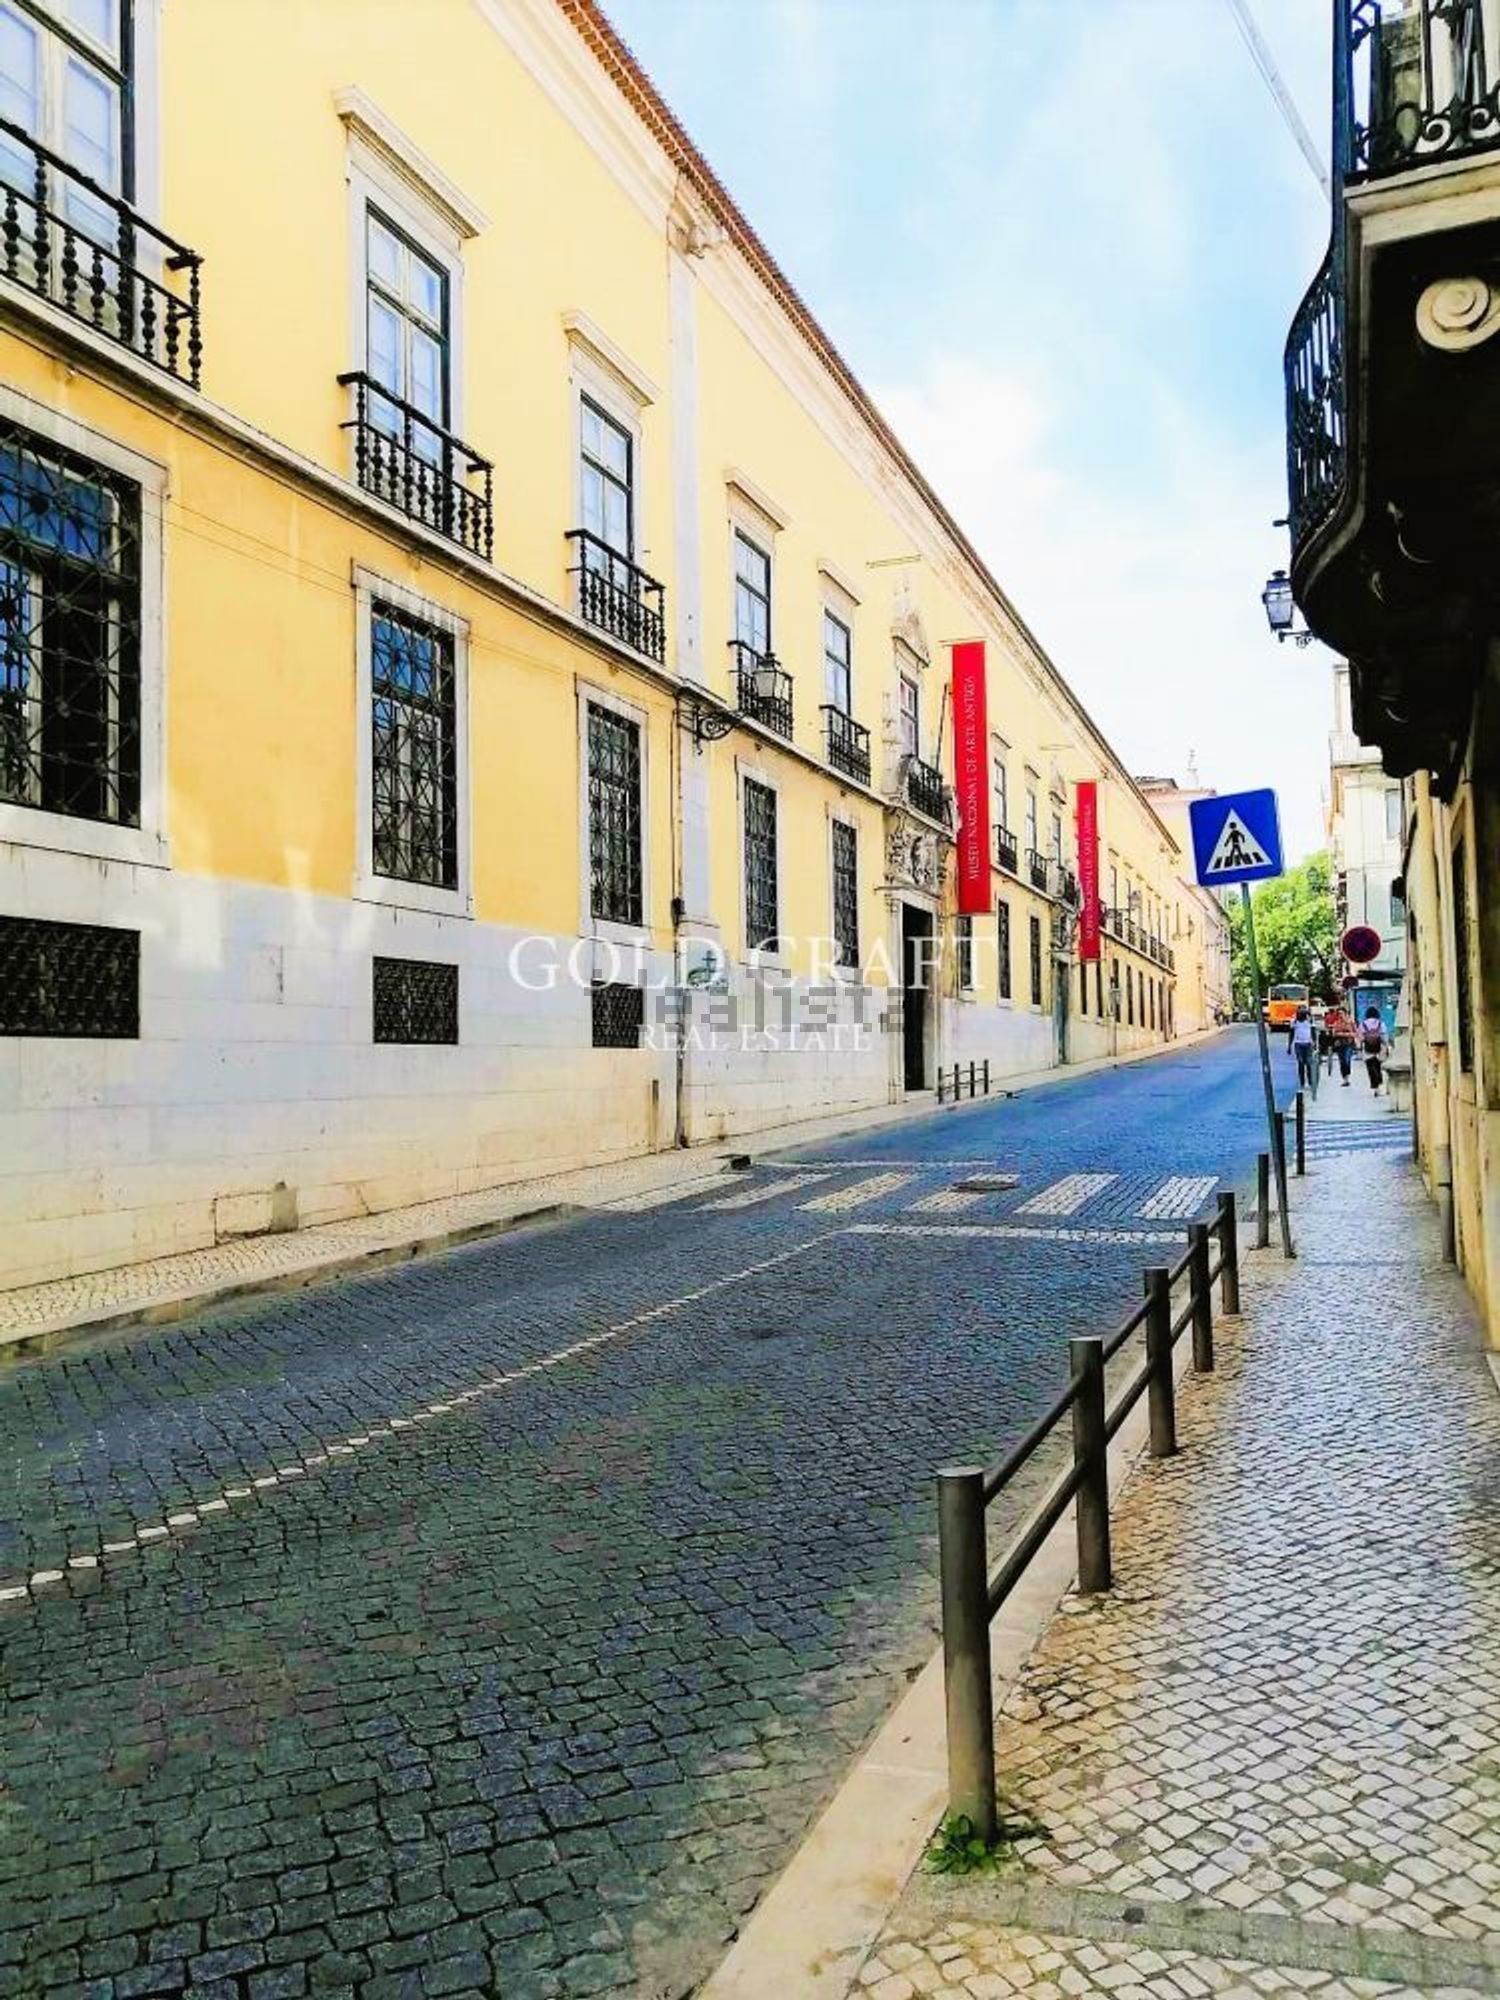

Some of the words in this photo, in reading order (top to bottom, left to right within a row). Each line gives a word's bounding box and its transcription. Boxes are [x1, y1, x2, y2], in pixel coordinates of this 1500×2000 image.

[965, 723, 976, 755] ARTE
[965, 757, 977, 773] DE
[967, 840, 980, 880] MUSEU
